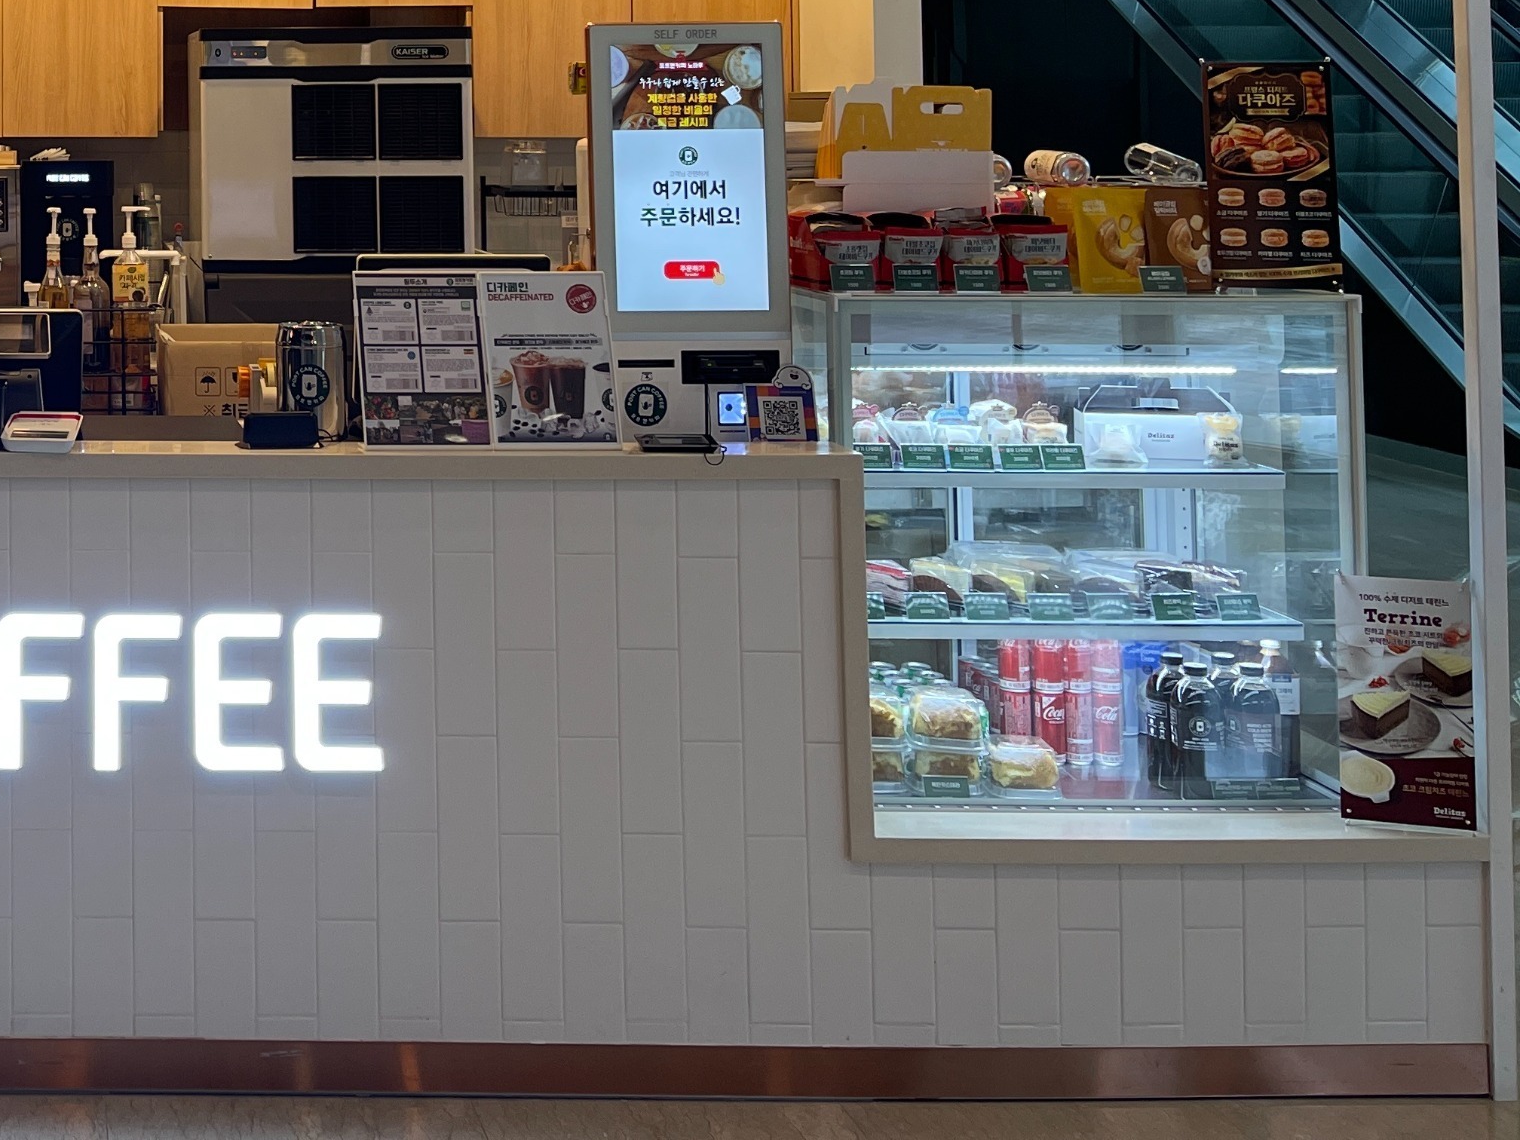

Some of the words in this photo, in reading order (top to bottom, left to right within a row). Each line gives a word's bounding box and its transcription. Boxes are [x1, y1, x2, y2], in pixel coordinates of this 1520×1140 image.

[654, 29, 679, 39] SELF
[685, 29, 717, 39] ORDER
[688, 92, 718, 104] 사용한
[1237, 93, 1297, 107] 다쿠아즈
[652, 105, 682, 116] 일정한
[683, 105, 713, 116] 비율의
[679, 117, 709, 127] 레시피
[653, 180, 726, 200] 여기에서
[640, 206, 740, 227] 주문하세요!
[486, 282, 529, 293] 디카페인
[488, 293, 554, 301] DECAFFEINATED
[292, 370, 301, 388] PORT
[313, 367, 328, 389] COFFEE
[627, 390, 638, 406] PORT
[650, 388, 665, 409] COFFEE
[1384, 594, 1399, 603] 수제
[1401, 596, 1424, 604] 디저트
[1426, 597, 1449, 607] 테린느
[1364, 609, 1442, 627] Terrine
[1402, 784, 1416, 792] 초코
[1418, 786, 1447, 795] 크림치즈
